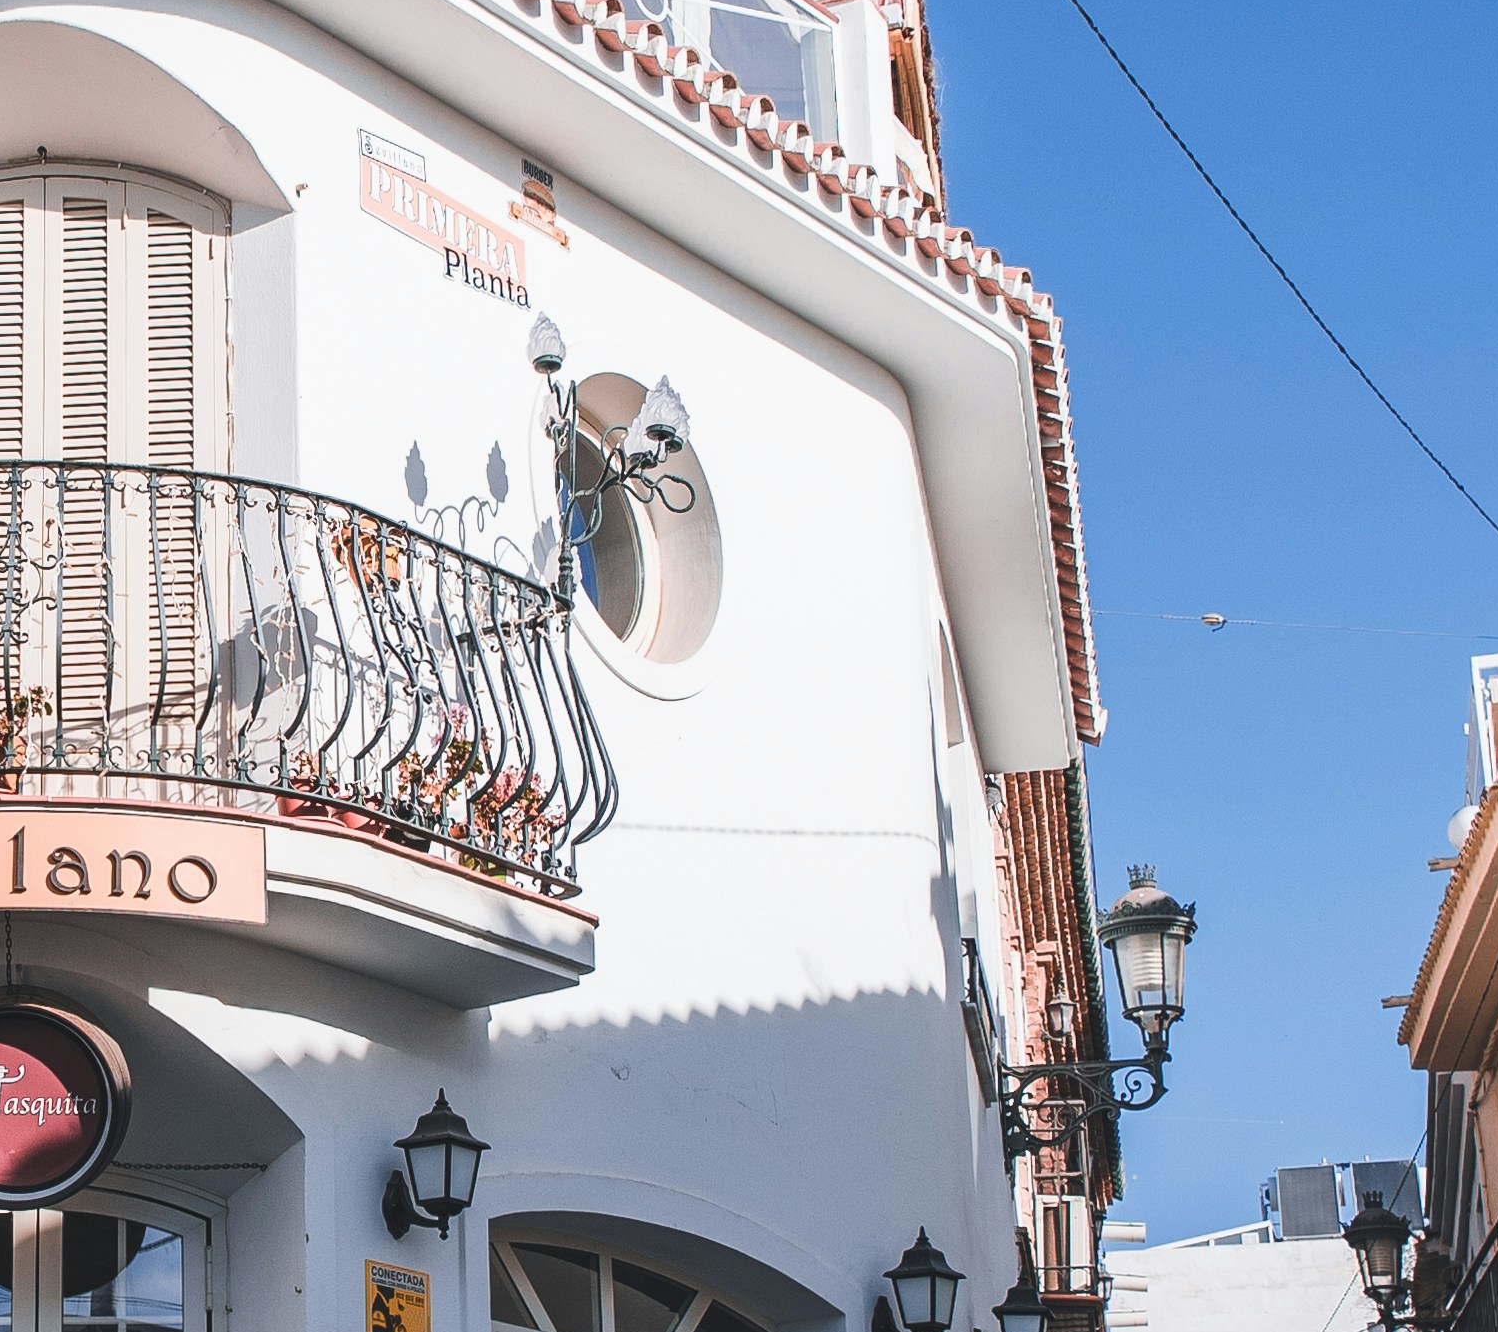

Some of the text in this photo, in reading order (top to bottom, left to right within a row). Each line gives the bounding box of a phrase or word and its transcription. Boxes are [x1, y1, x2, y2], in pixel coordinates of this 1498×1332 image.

[523, 159, 554, 190] BURGER
[369, 161, 520, 282] PRIMERA
[443, 246, 531, 309] Planta
[371, 1265, 425, 1288] CONECTADA
